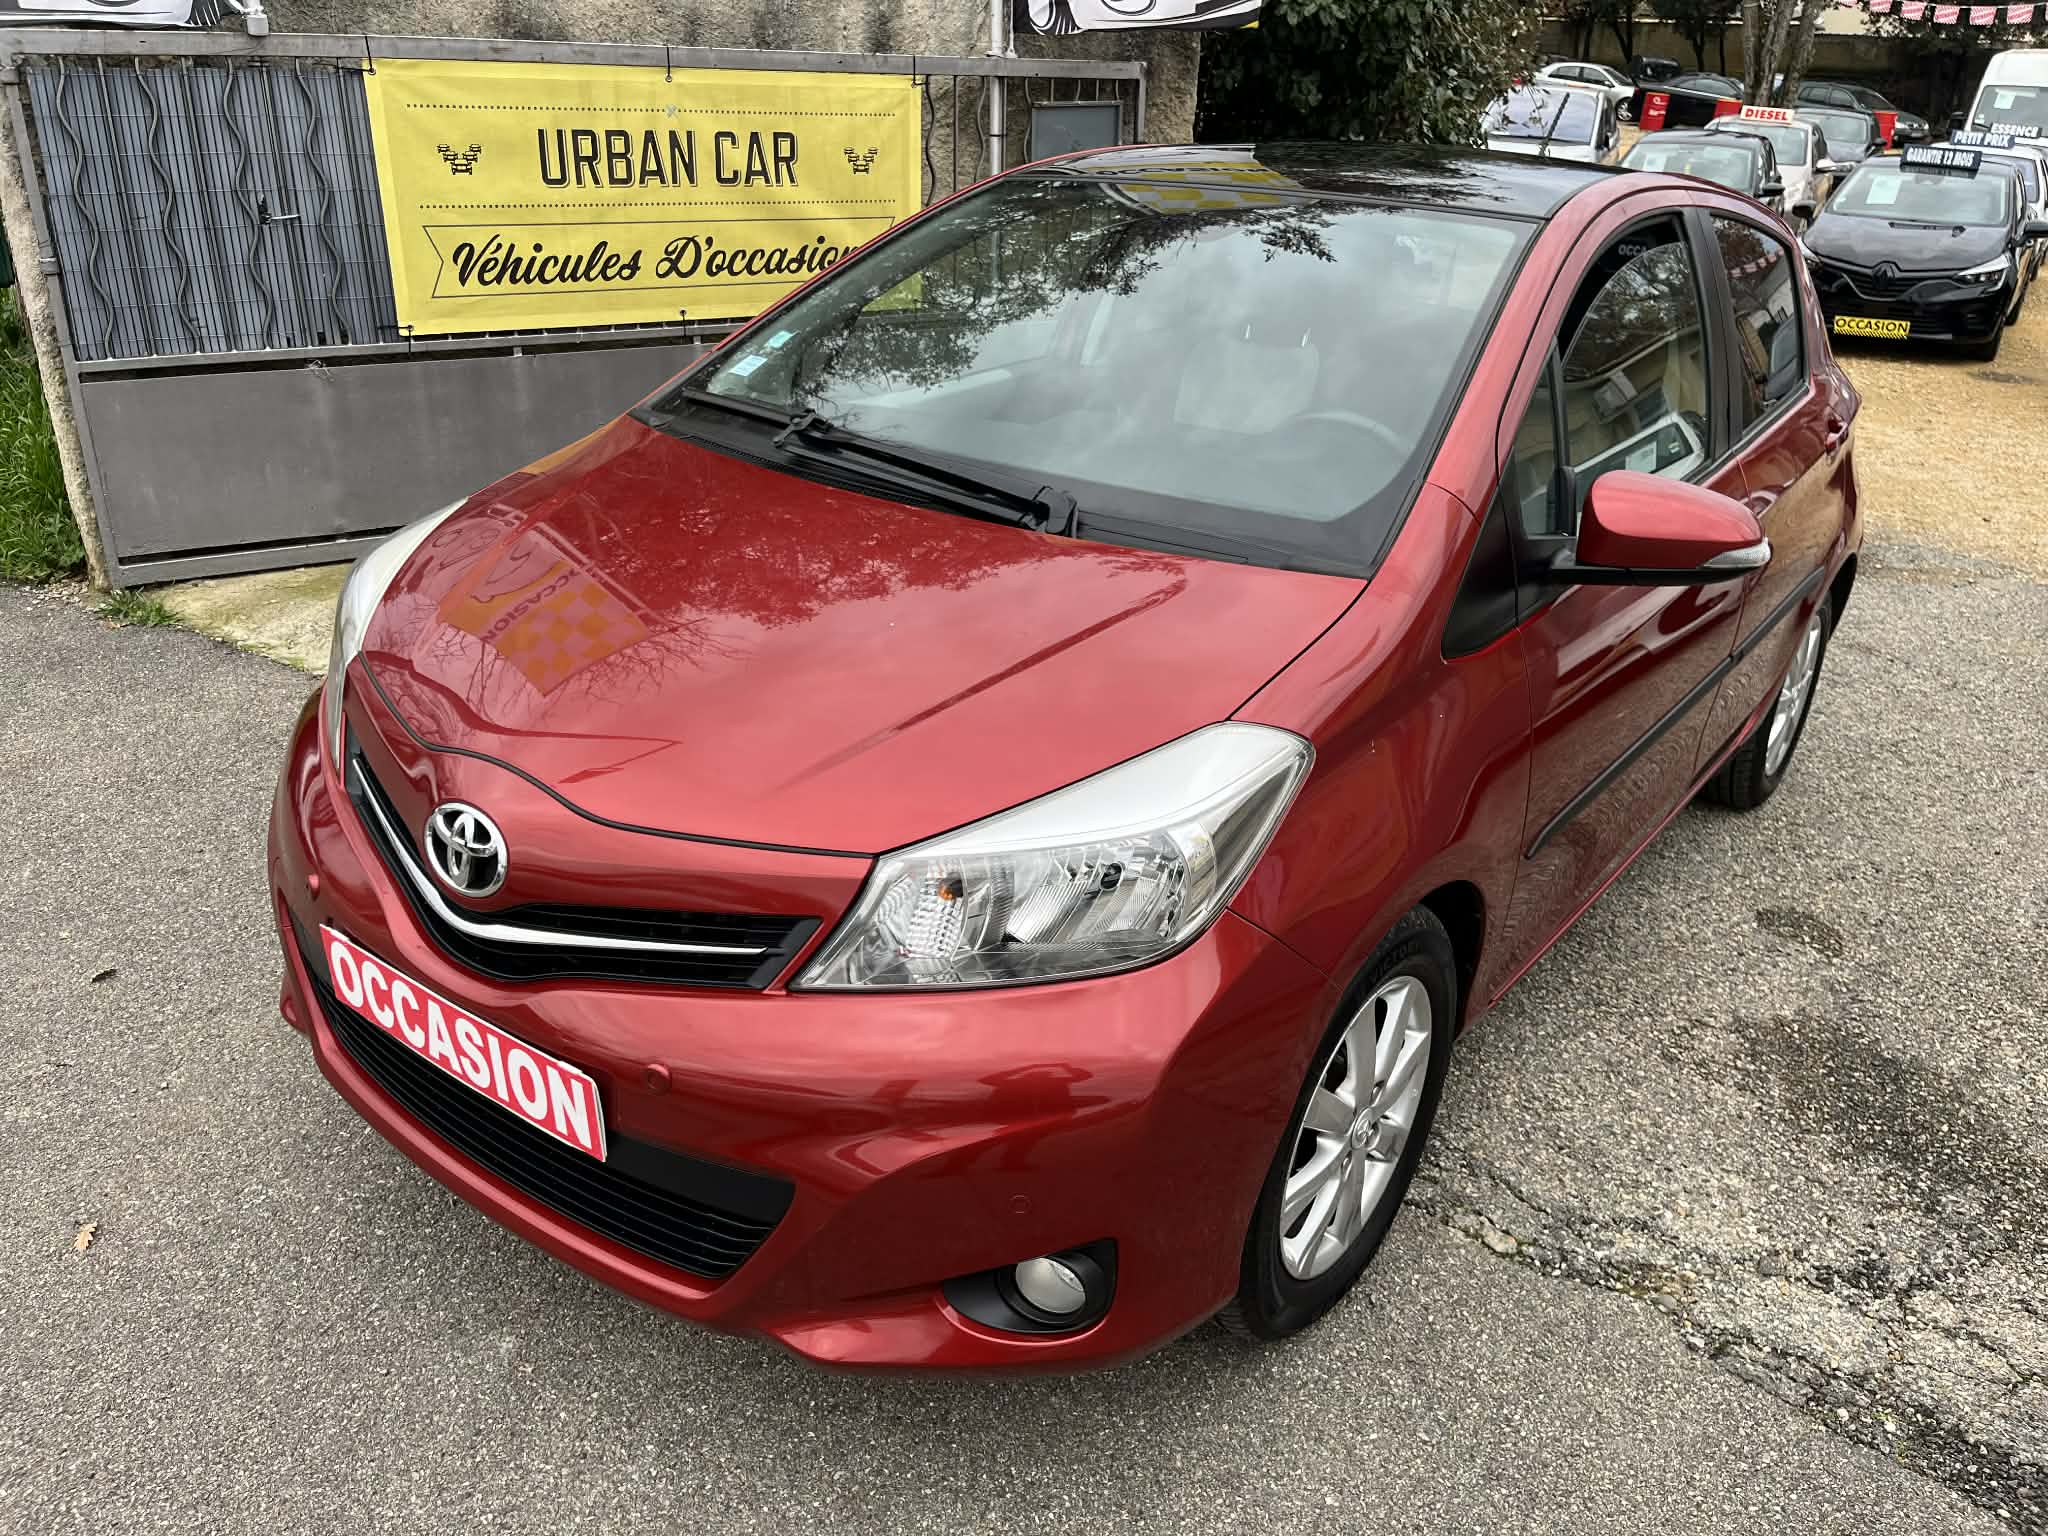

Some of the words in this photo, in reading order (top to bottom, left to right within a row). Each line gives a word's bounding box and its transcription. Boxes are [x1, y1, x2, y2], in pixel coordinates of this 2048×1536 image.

[1744, 108, 1788, 121] DIESEL
[1953, 130, 1983, 145] PETIT
[1983, 132, 2011, 148] PRIX
[537, 127, 698, 188] URBAN
[713, 131, 799, 188] CAR
[1906, 146, 1943, 165] GARANTIE
[1953, 150, 1975, 168] MOIS
[453, 234, 642, 288] Véhicules
[1835, 318, 1908, 333] OCCASION
[329, 939, 593, 1150] OCCASION
